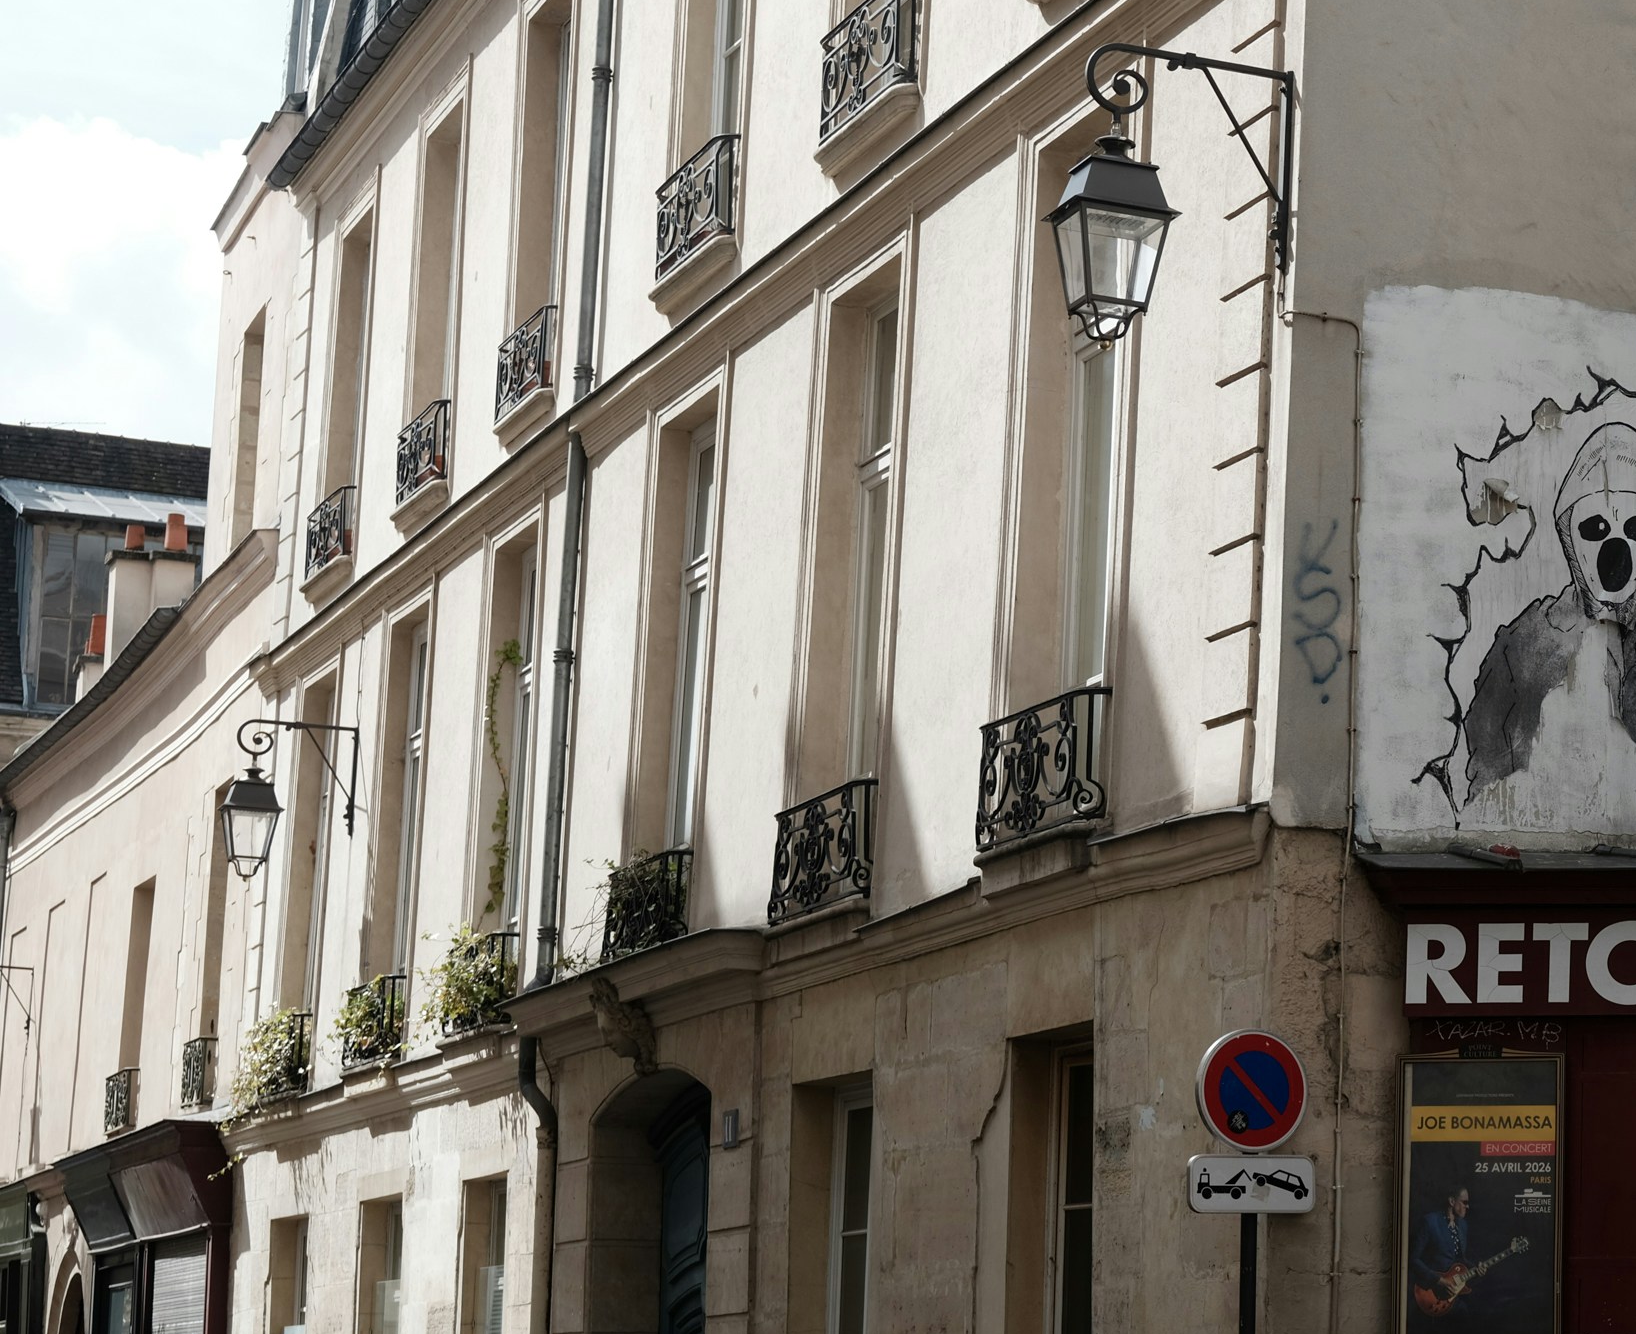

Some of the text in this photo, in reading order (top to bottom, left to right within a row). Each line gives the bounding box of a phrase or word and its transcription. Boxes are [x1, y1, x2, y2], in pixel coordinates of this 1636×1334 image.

[1417, 1116, 1552, 1129] JOE BONAMASSA
[1486, 1143, 1552, 1153] EN CONCERT
[1475, 1162, 1551, 1173] 25 AVRIL 2026
[1530, 1176, 1551, 1184] PARIS
[1514, 1198, 1526, 1206] LA
